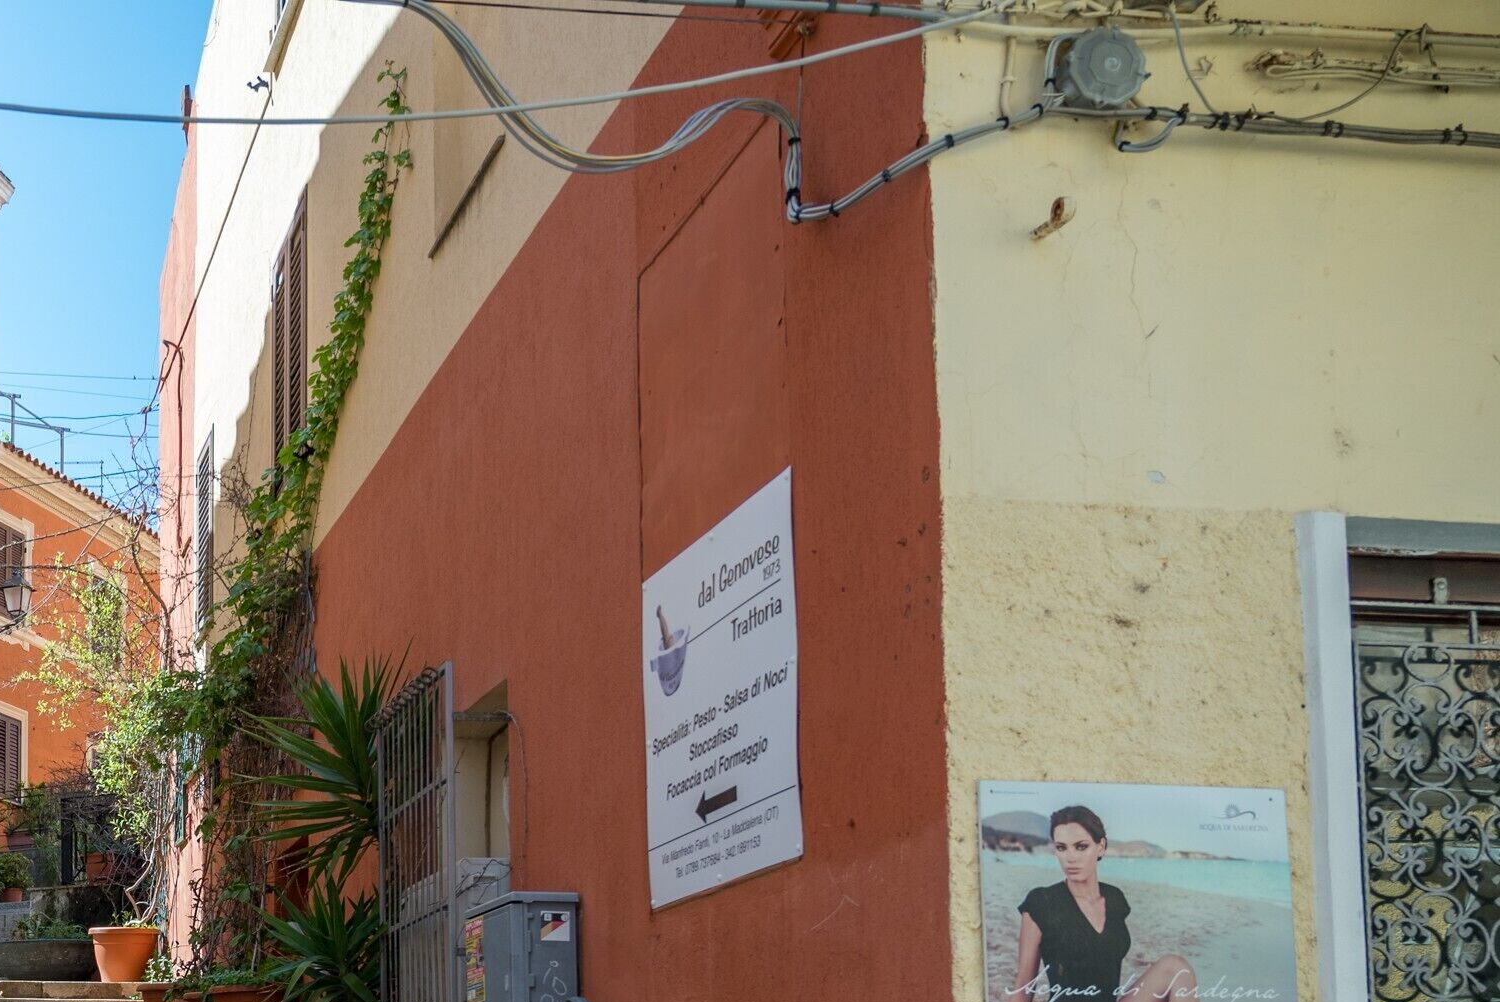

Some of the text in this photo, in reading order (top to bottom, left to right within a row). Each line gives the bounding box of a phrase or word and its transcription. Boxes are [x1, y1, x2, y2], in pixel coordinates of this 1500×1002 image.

[697, 534, 780, 609] dal Genovese
[762, 558, 781, 582] 1973
[730, 596, 783, 642] Trattoria
[692, 706, 717, 732] Pesto
[723, 687, 749, 713] Salsa
[750, 676, 761, 698] di
[763, 661, 789, 692] Noci
[688, 723, 739, 761] Stoccafisso
[666, 735, 769, 801] Focaccia col Formaggio
[1112, 974, 1145, 997] di
